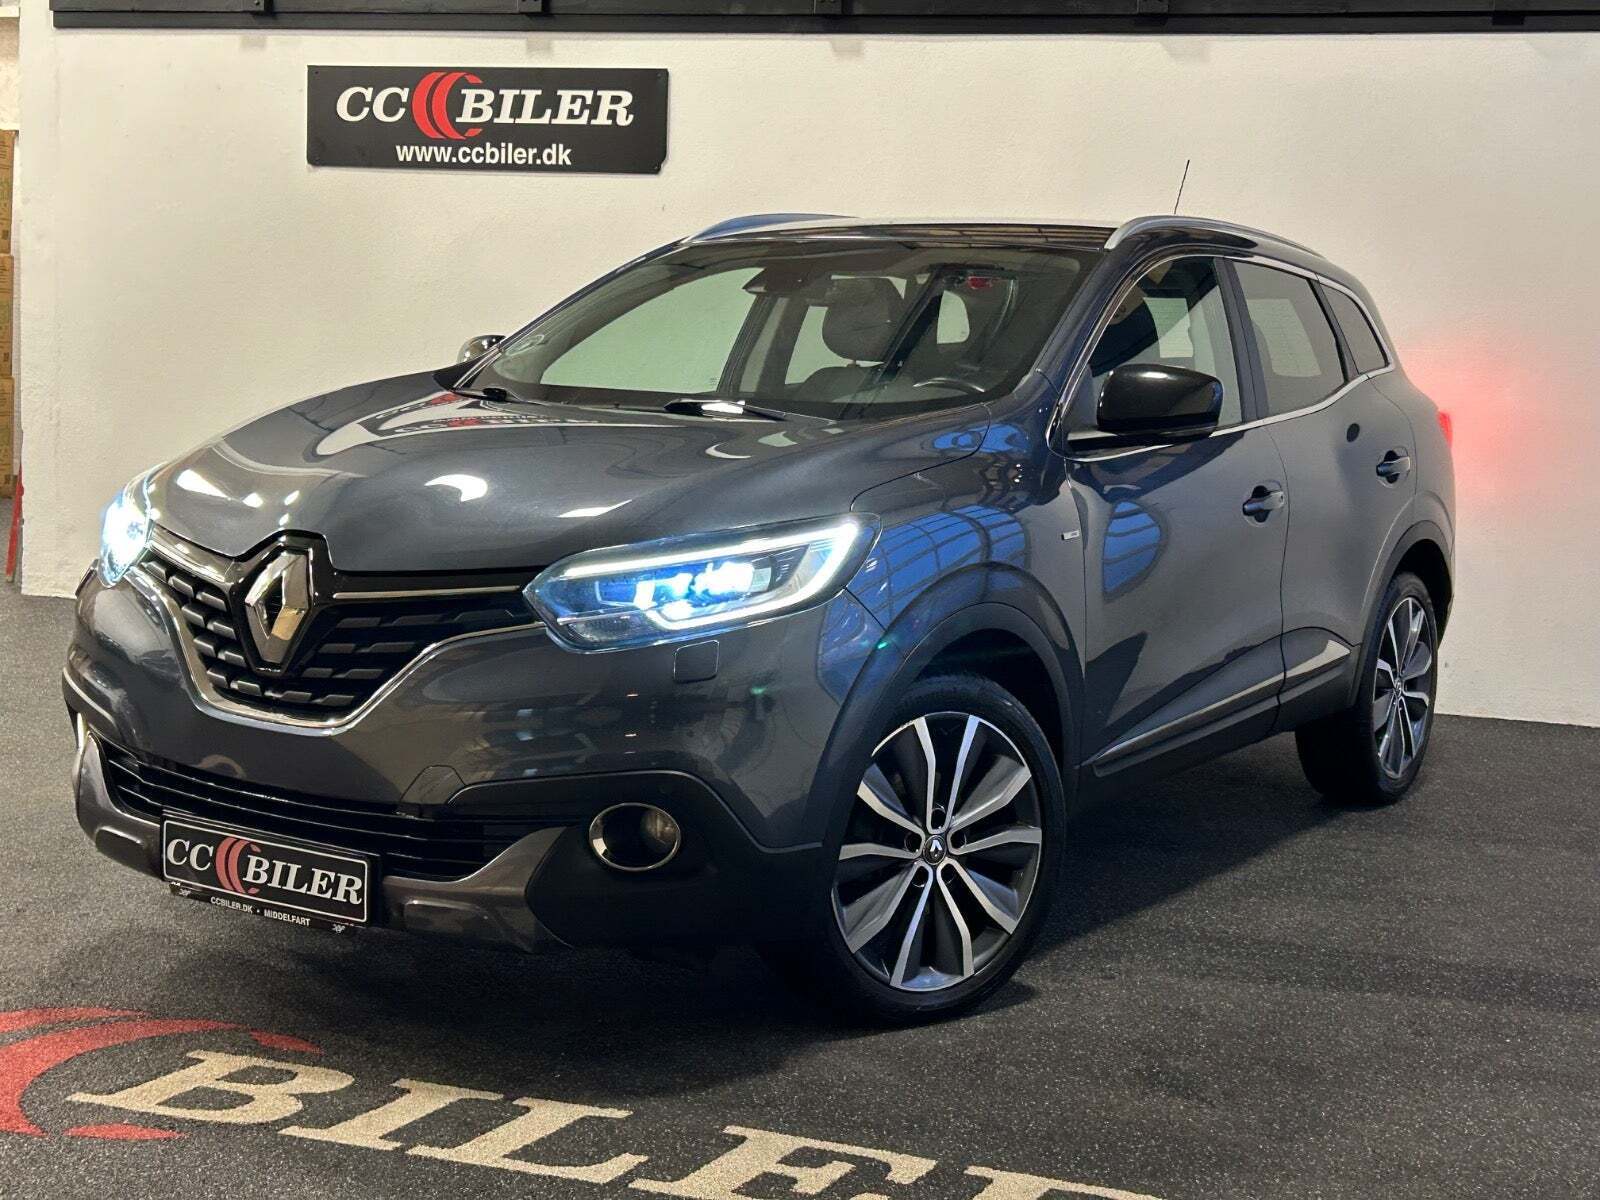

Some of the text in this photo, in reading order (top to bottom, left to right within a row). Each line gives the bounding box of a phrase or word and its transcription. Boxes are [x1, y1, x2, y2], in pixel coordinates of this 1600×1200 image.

[336, 86, 635, 127] CC BILER
[395, 142, 572, 166] www.ccbiler.dk
[166, 838, 362, 905] CC BILER
[210, 896, 311, 927] CCBILER.DK MIDDELFART
